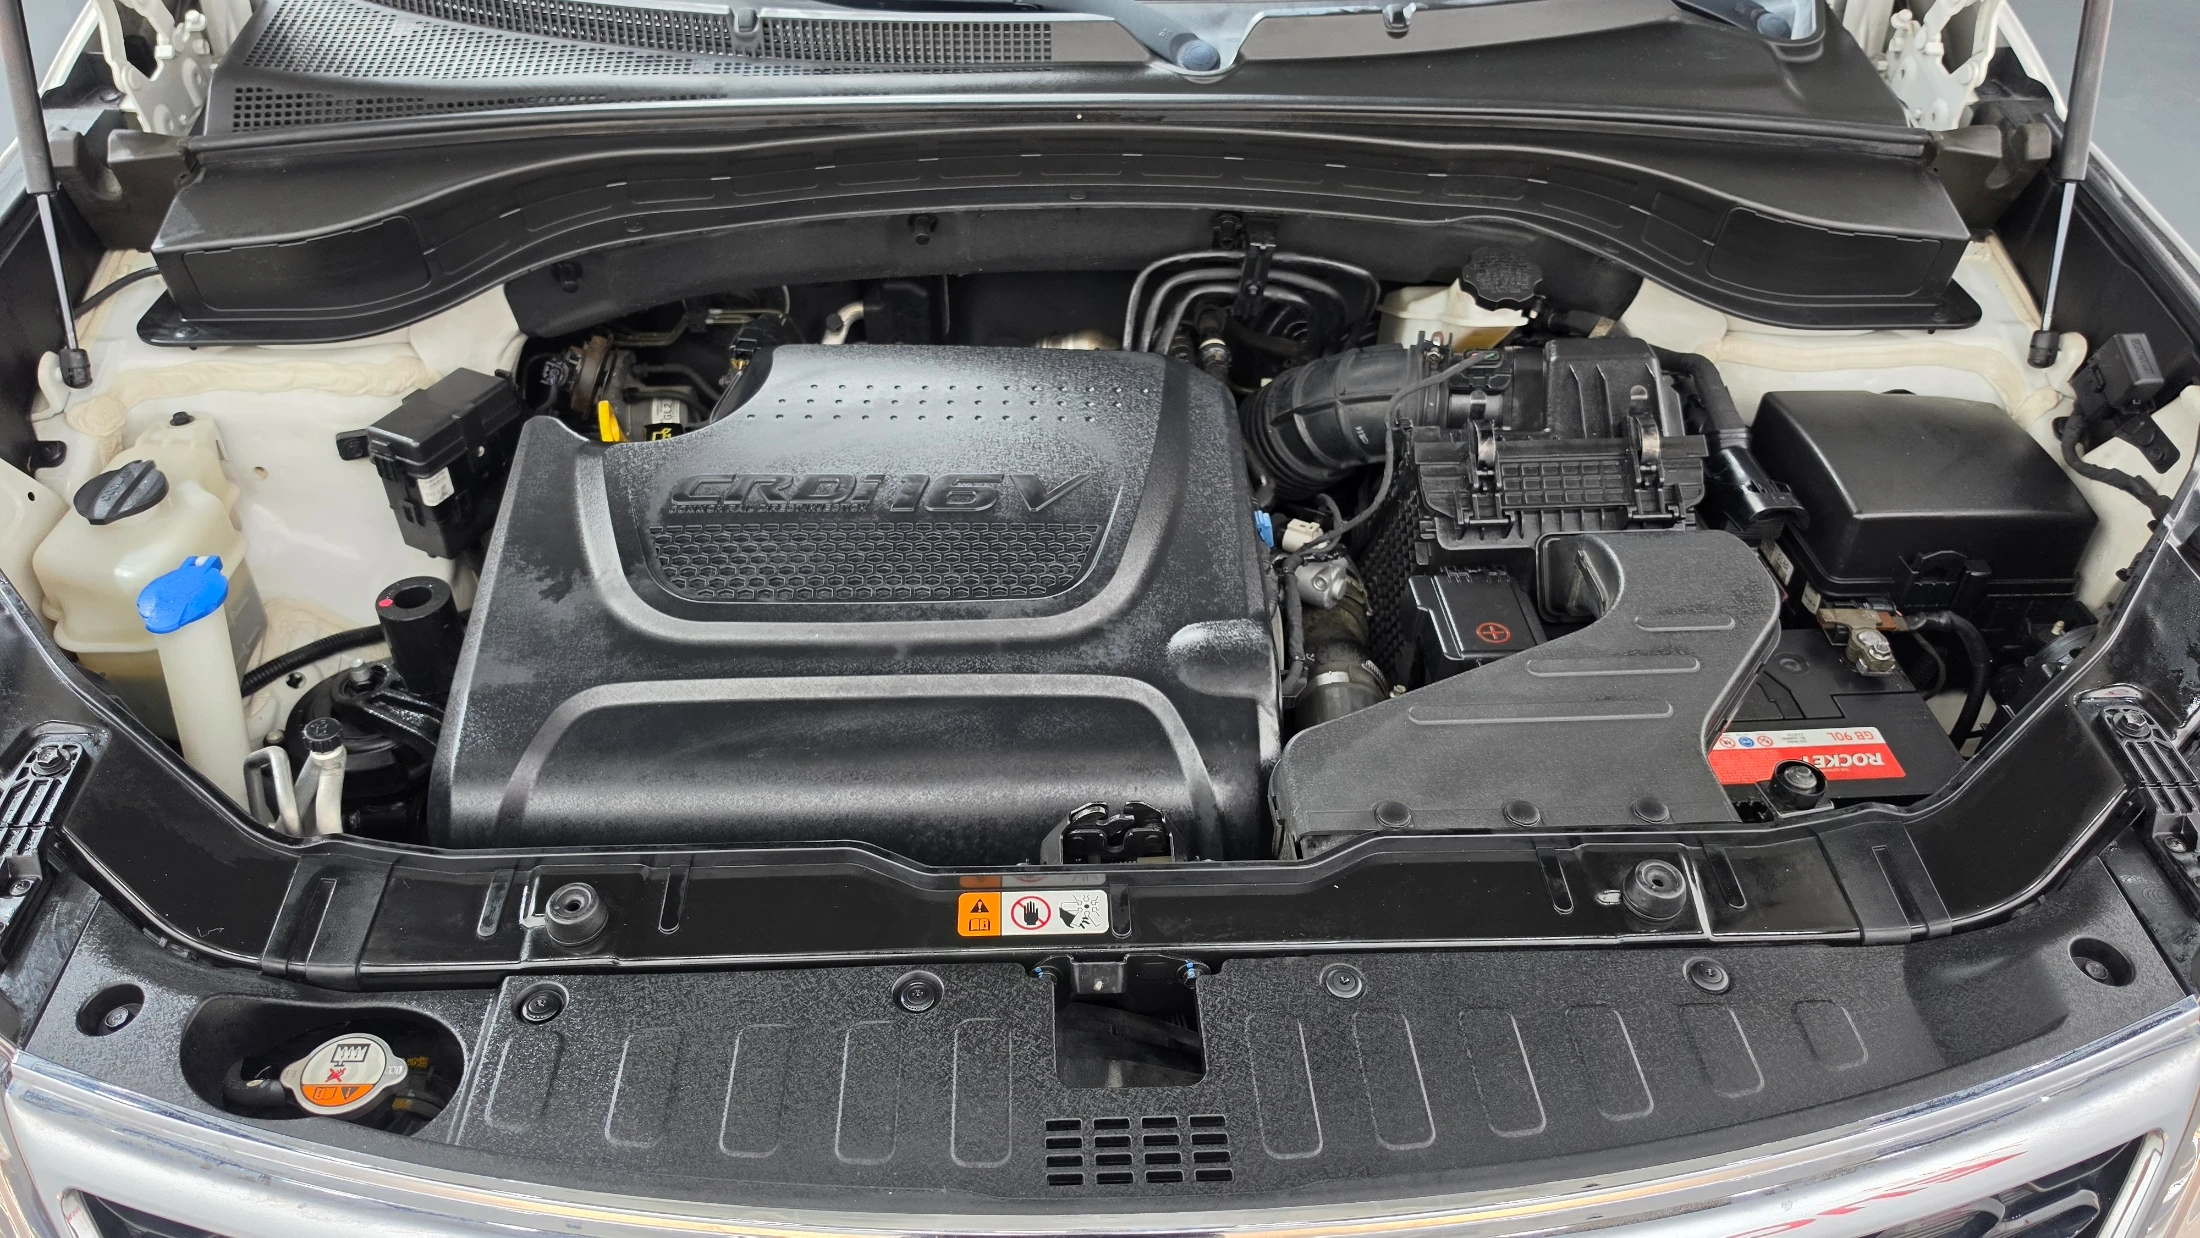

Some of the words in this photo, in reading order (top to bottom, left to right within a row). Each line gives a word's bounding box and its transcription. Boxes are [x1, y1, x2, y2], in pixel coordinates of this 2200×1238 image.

[671, 473, 886, 505] CRDi
[1826, 731, 1853, 742] 90L
[1854, 730, 1875, 741] GB
